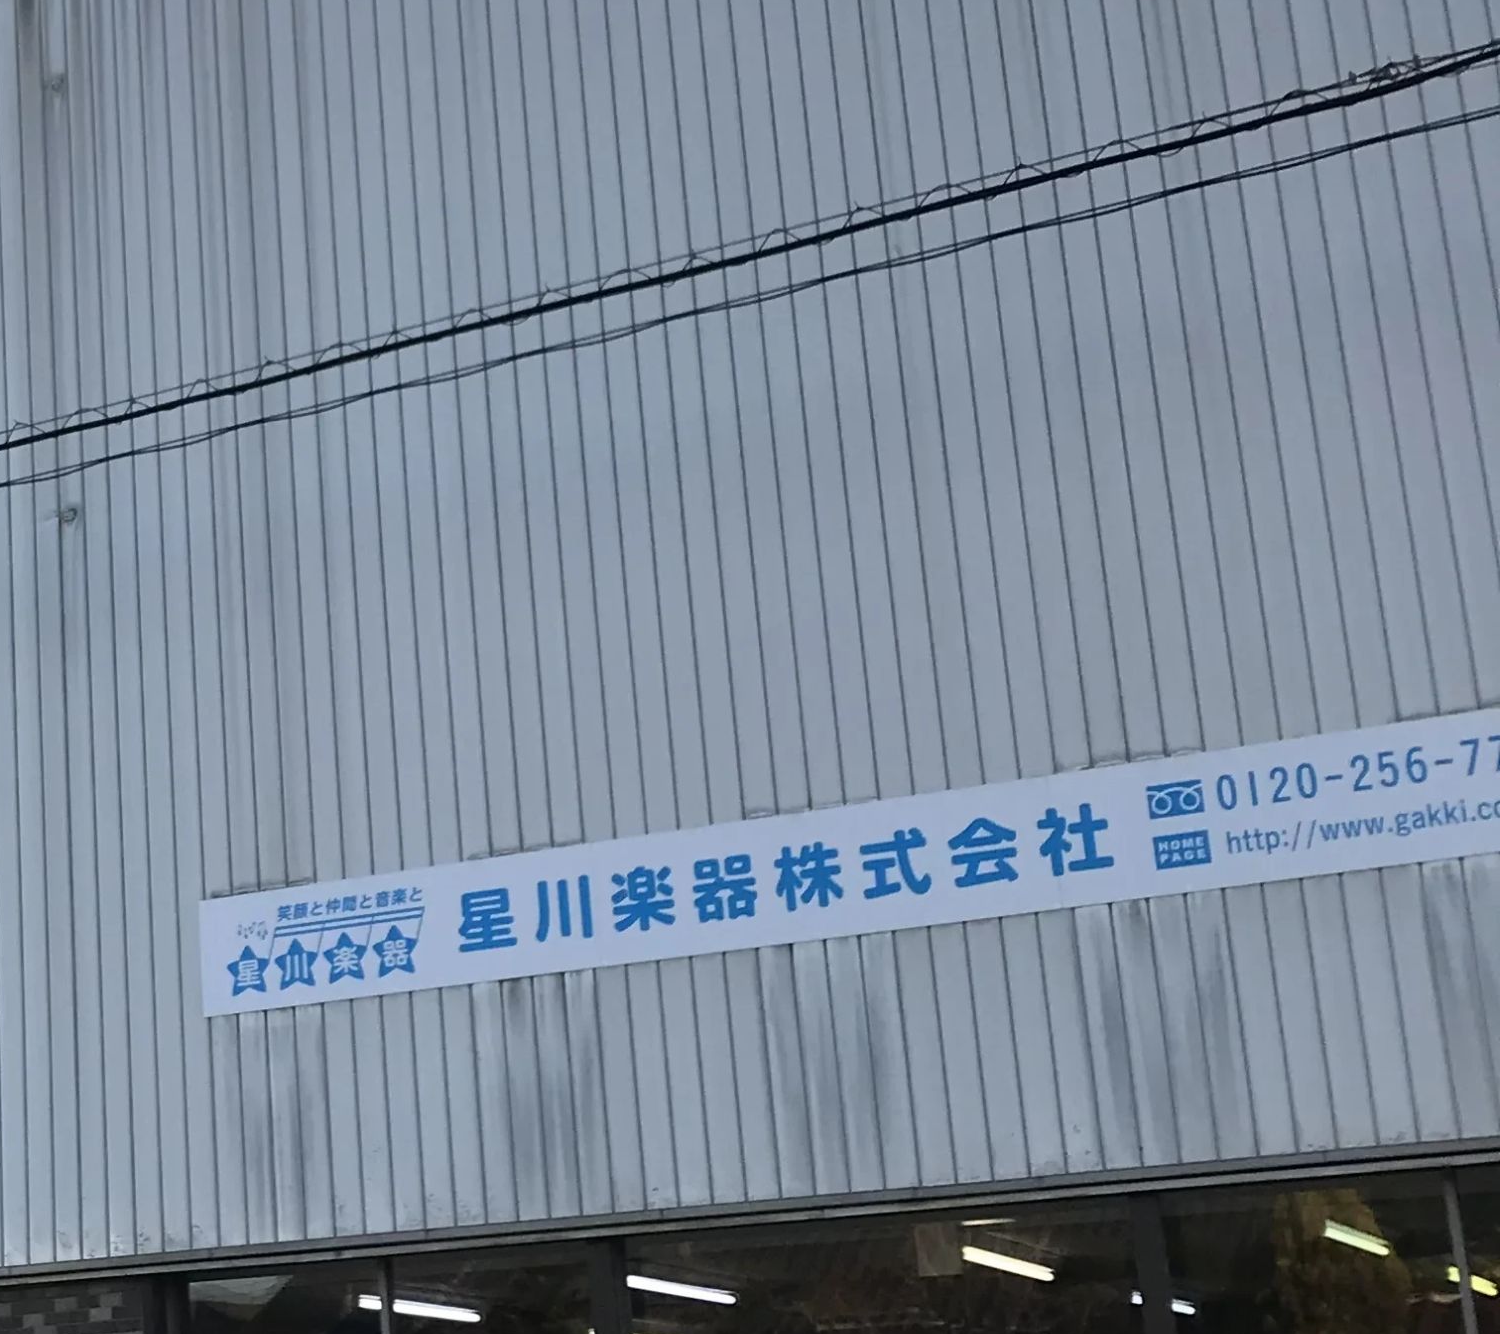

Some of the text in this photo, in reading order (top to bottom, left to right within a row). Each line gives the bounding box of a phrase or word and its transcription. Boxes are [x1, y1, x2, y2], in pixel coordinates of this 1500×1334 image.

[1157, 836, 1205, 852] HOME
[1159, 848, 1207, 865] PAGE
[457, 802, 1115, 953] 星川楽器株式会社
[276, 886, 424, 923] 笑顔と仲間と音楽と
[236, 938, 410, 988] 星川楽器
